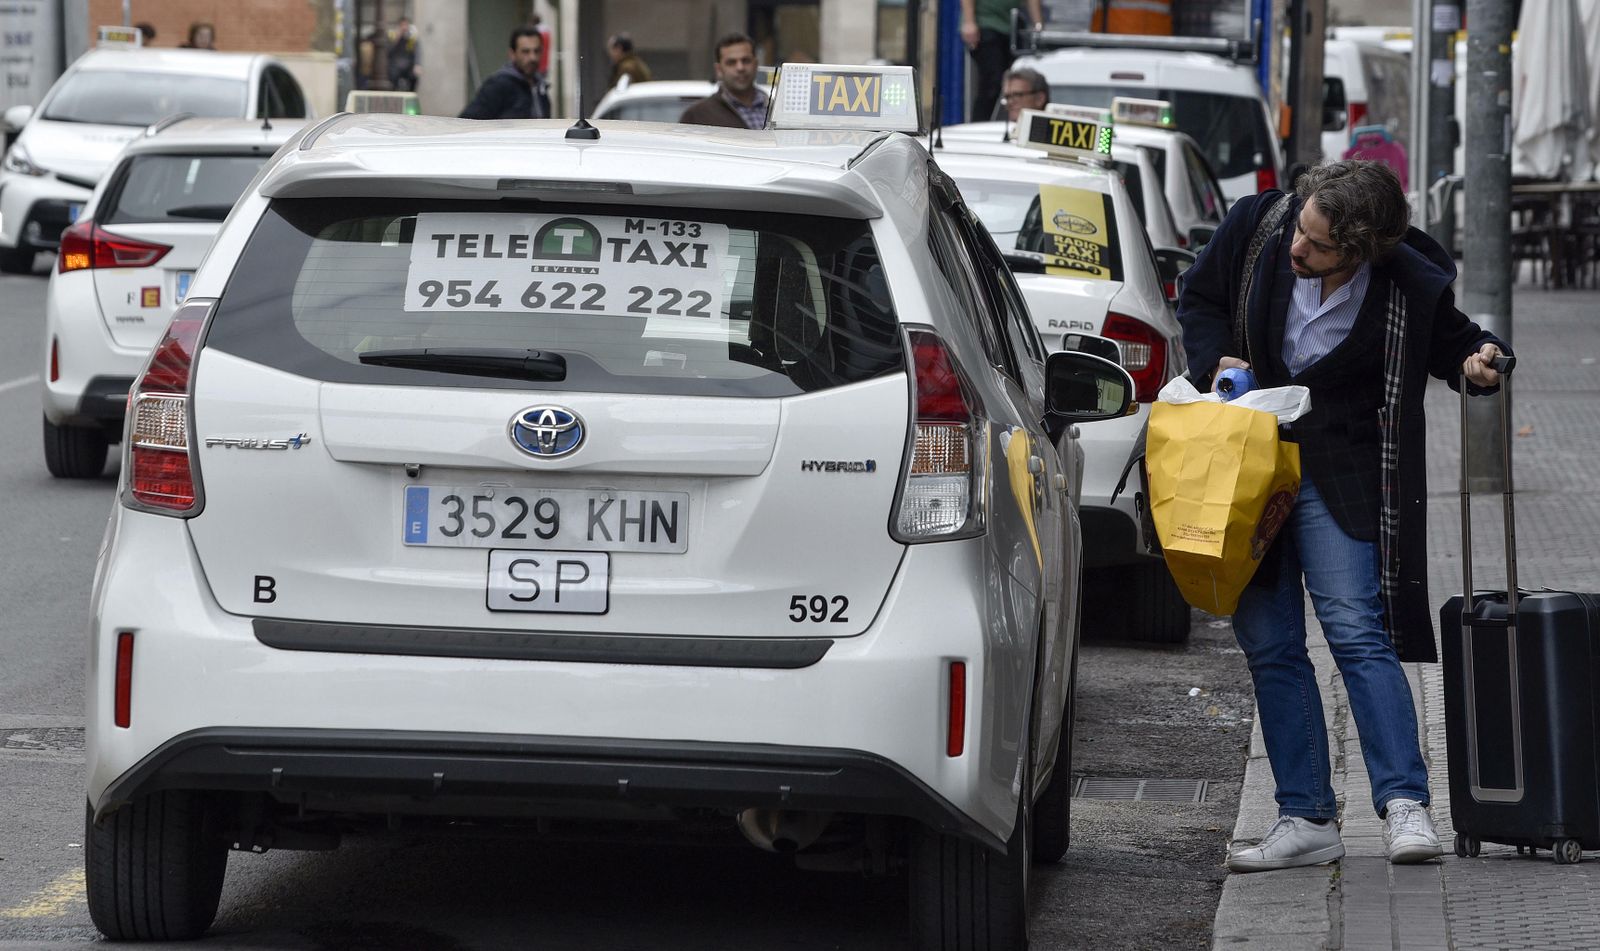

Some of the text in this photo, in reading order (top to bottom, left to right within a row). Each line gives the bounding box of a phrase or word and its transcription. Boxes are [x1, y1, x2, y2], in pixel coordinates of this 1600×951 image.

[812, 75, 881, 113] TAXI
[1049, 119, 1097, 150] TAXI
[624, 218, 702, 239] M-133
[1053, 234, 1100, 251] RADIO
[431, 233, 530, 259] TELE
[606, 237, 709, 269] TAXI
[1054, 242, 1101, 264] TAXI
[532, 265, 598, 275] SEVILLA
[418, 280, 713, 318] 954 622 222
[1048, 319, 1094, 331] RAPID
[801, 460, 865, 472] HYBRID
[411, 494, 679, 544] E 3529 KHN
[253, 575, 277, 604] B
[508, 558, 590, 603] SP
[788, 594, 850, 623] 592
